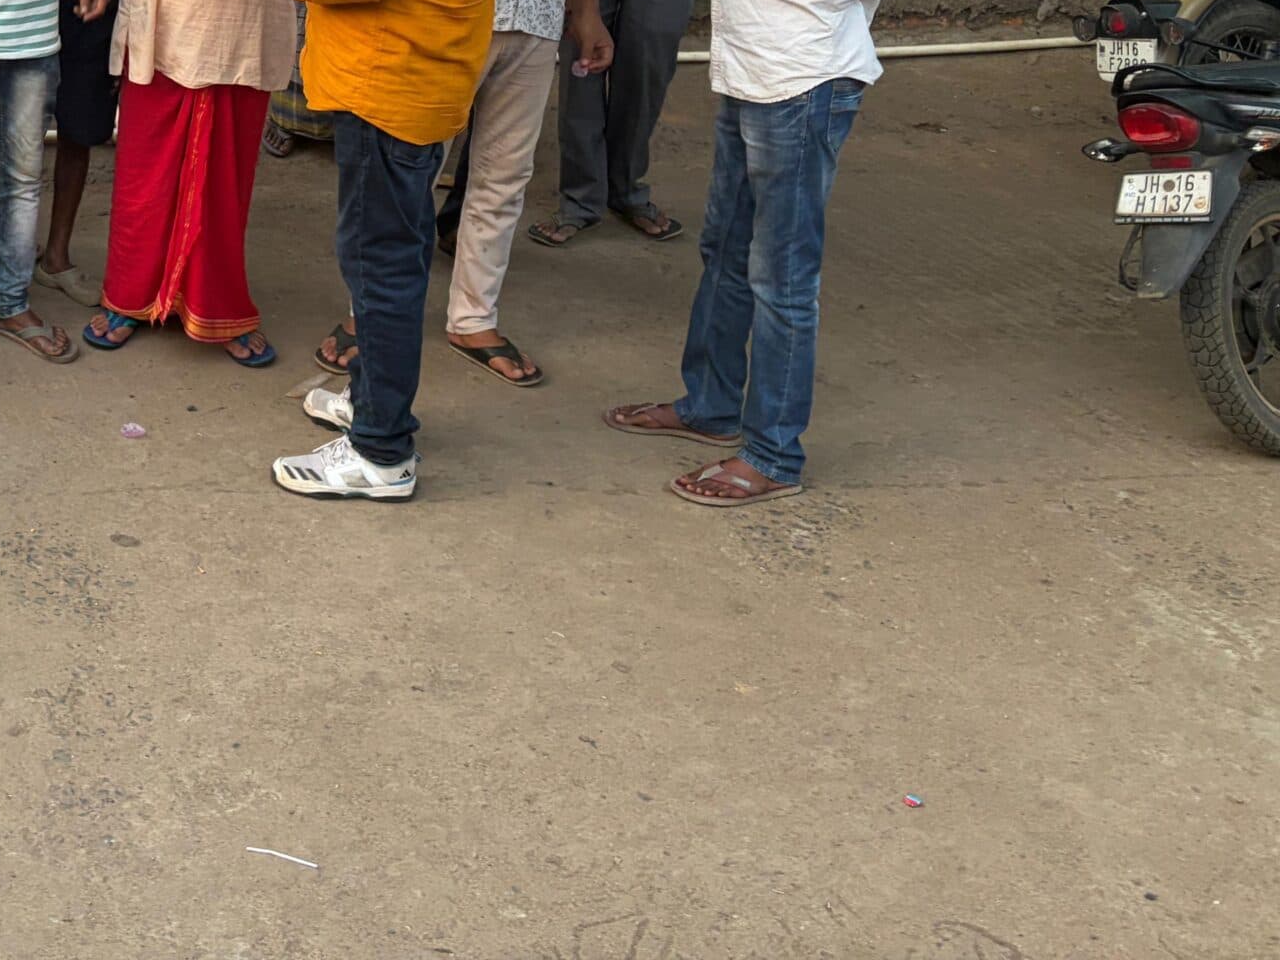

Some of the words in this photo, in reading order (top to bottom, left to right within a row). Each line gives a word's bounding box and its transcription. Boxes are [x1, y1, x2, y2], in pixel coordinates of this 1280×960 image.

[1110, 41, 1139, 56] JH16
[1139, 175, 1160, 194] JH
[1176, 174, 1195, 193] 16
[1135, 194, 1193, 213] H1137
